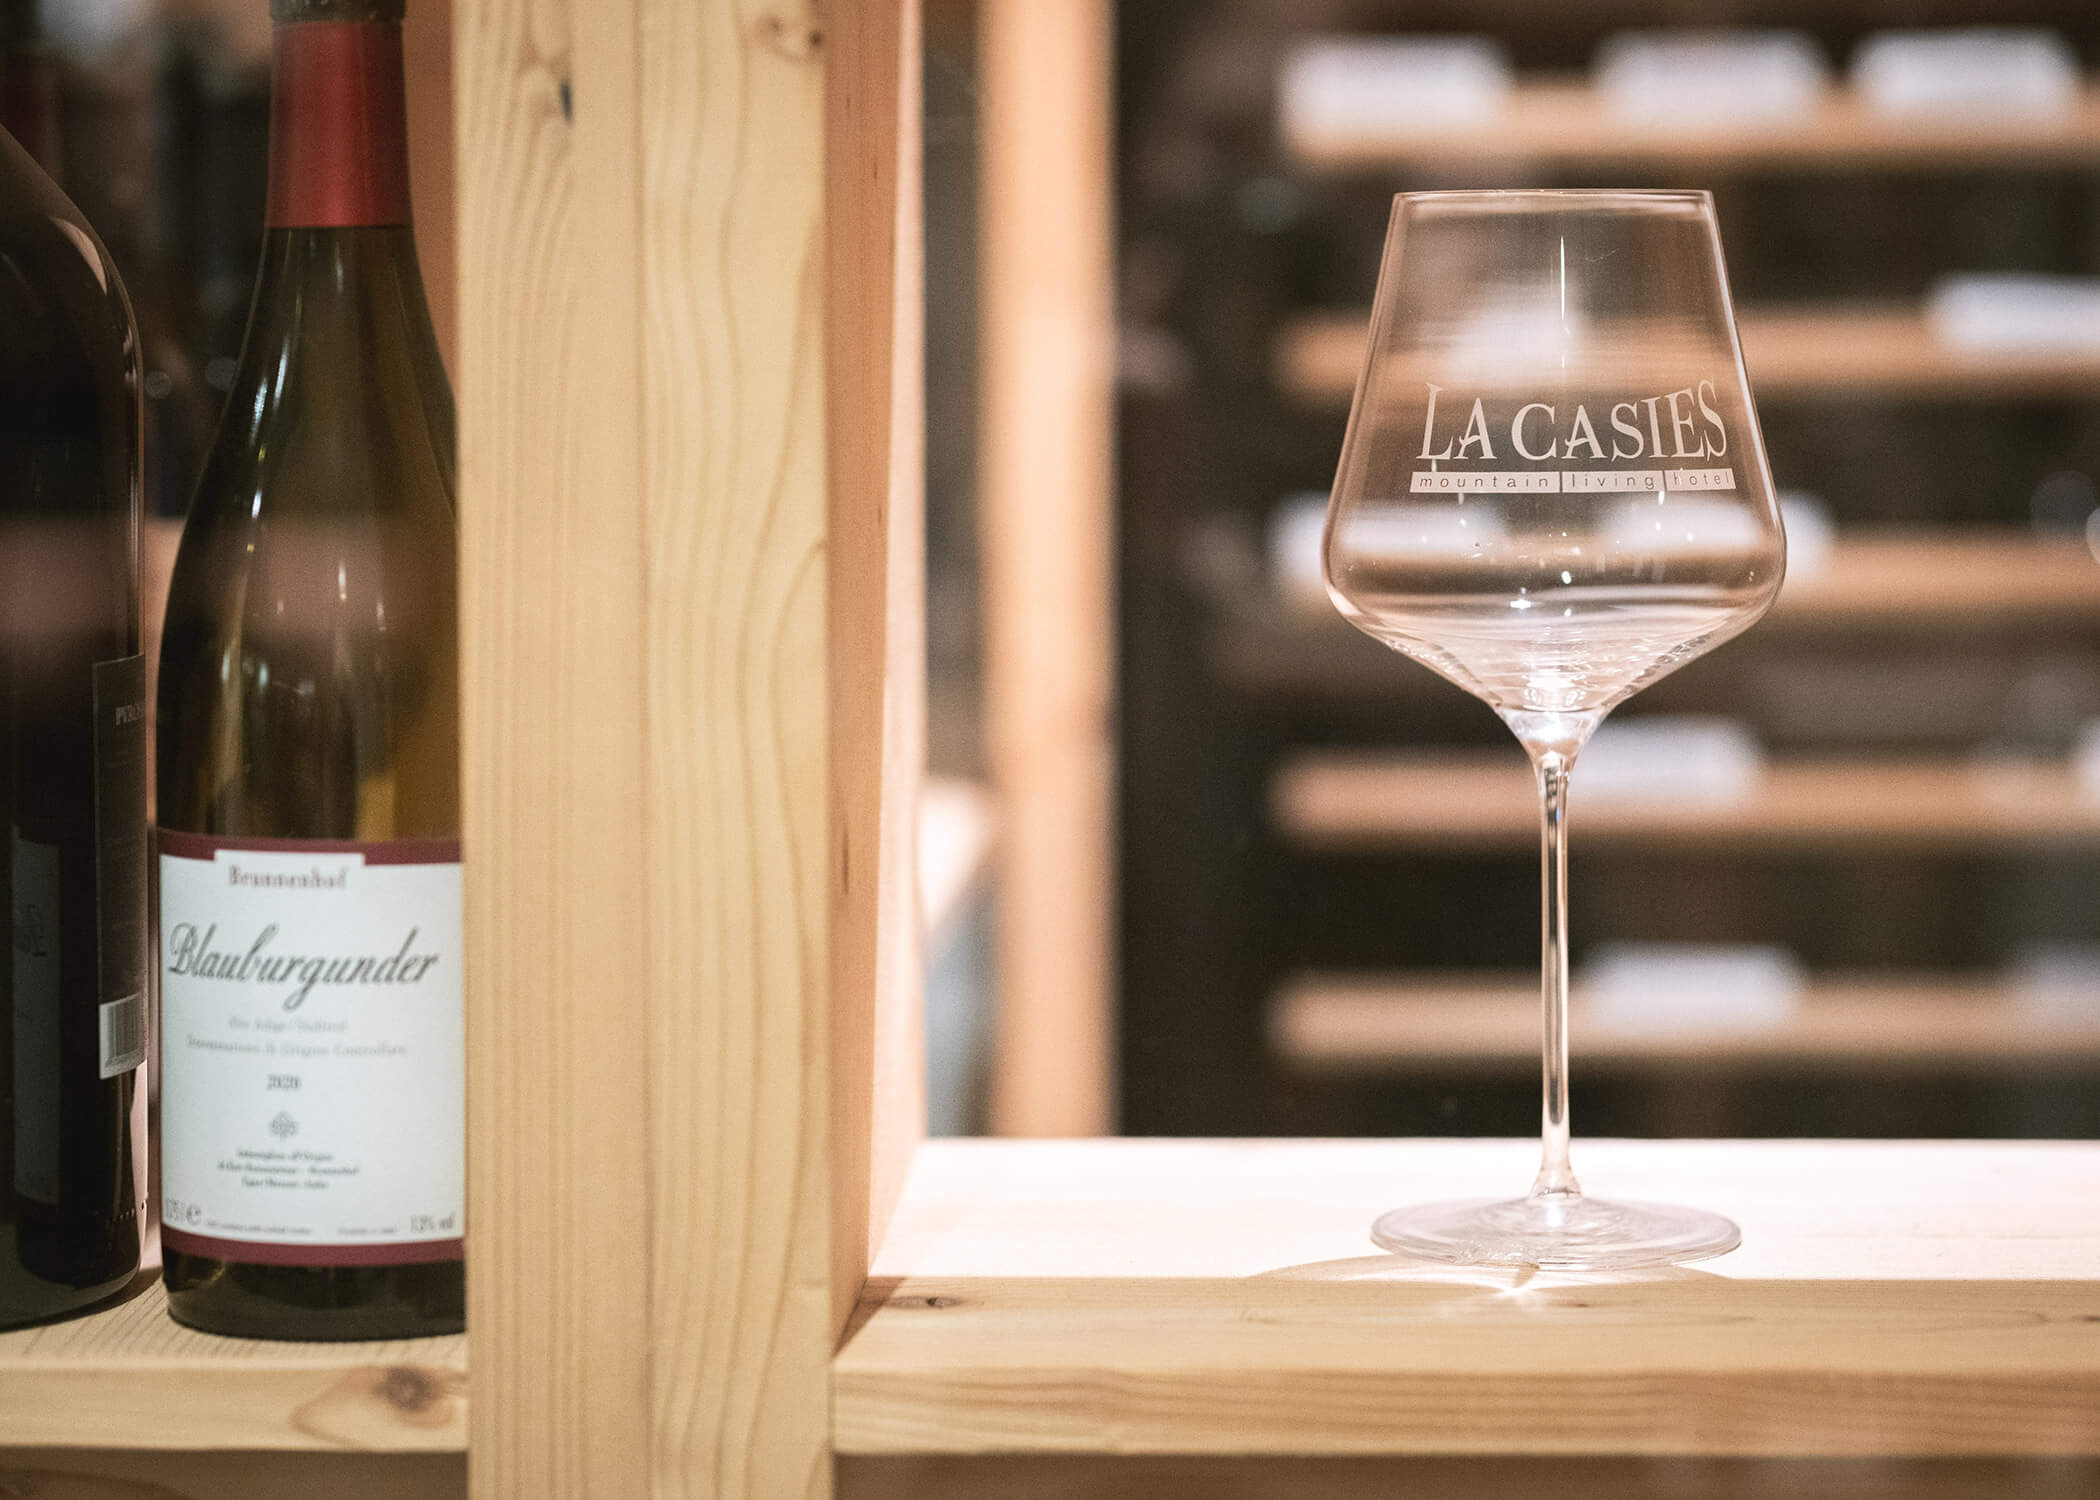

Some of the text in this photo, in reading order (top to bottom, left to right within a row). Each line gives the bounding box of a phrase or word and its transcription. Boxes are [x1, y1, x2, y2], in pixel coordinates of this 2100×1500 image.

[1416, 379, 1728, 462] LA CASIES
[1419, 470, 1730, 490] mountain living hotel
[167, 921, 440, 1011] Blauburgunder
